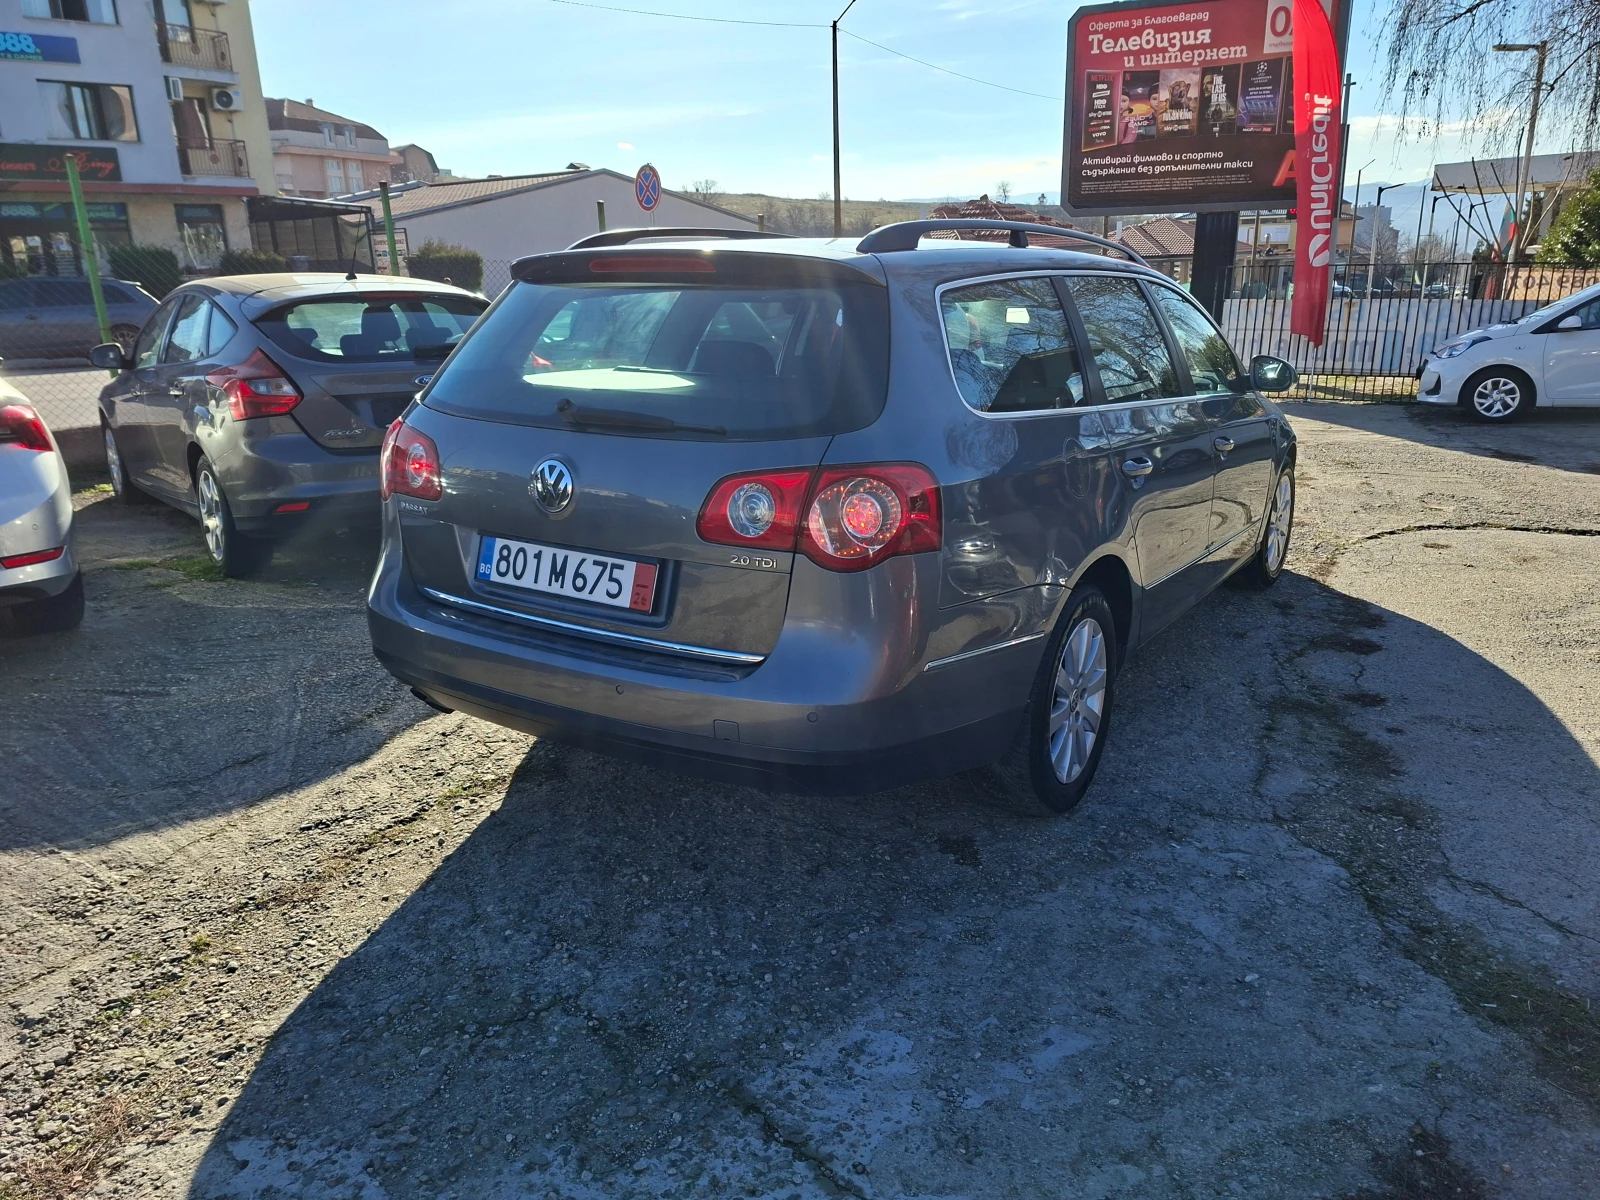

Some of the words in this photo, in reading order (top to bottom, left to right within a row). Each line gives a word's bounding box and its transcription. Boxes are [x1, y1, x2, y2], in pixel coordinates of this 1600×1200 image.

[1089, 20, 1129, 31] Оферта
[1131, 17, 1142, 28] за
[1144, 11, 1209, 25] Благоевград
[1088, 28, 1212, 54] Телевизия
[1124, 55, 1134, 67] и
[1140, 45, 1248, 66] интернет
[1091, 74, 1114, 82] NETFLIX
[1213, 75, 1224, 85] THE
[1212, 84, 1226, 93] LAST
[1082, 154, 1132, 166] Активирай
[1133, 153, 1172, 166] филмово
[1182, 151, 1224, 163] спортно
[1081, 165, 1136, 177] съдържание
[1137, 165, 1153, 175] без
[1154, 161, 1222, 174] допълнителни
[1223, 159, 1253, 169] такси
[401, 502, 428, 515] PASSAT
[479, 562, 492, 574] BG
